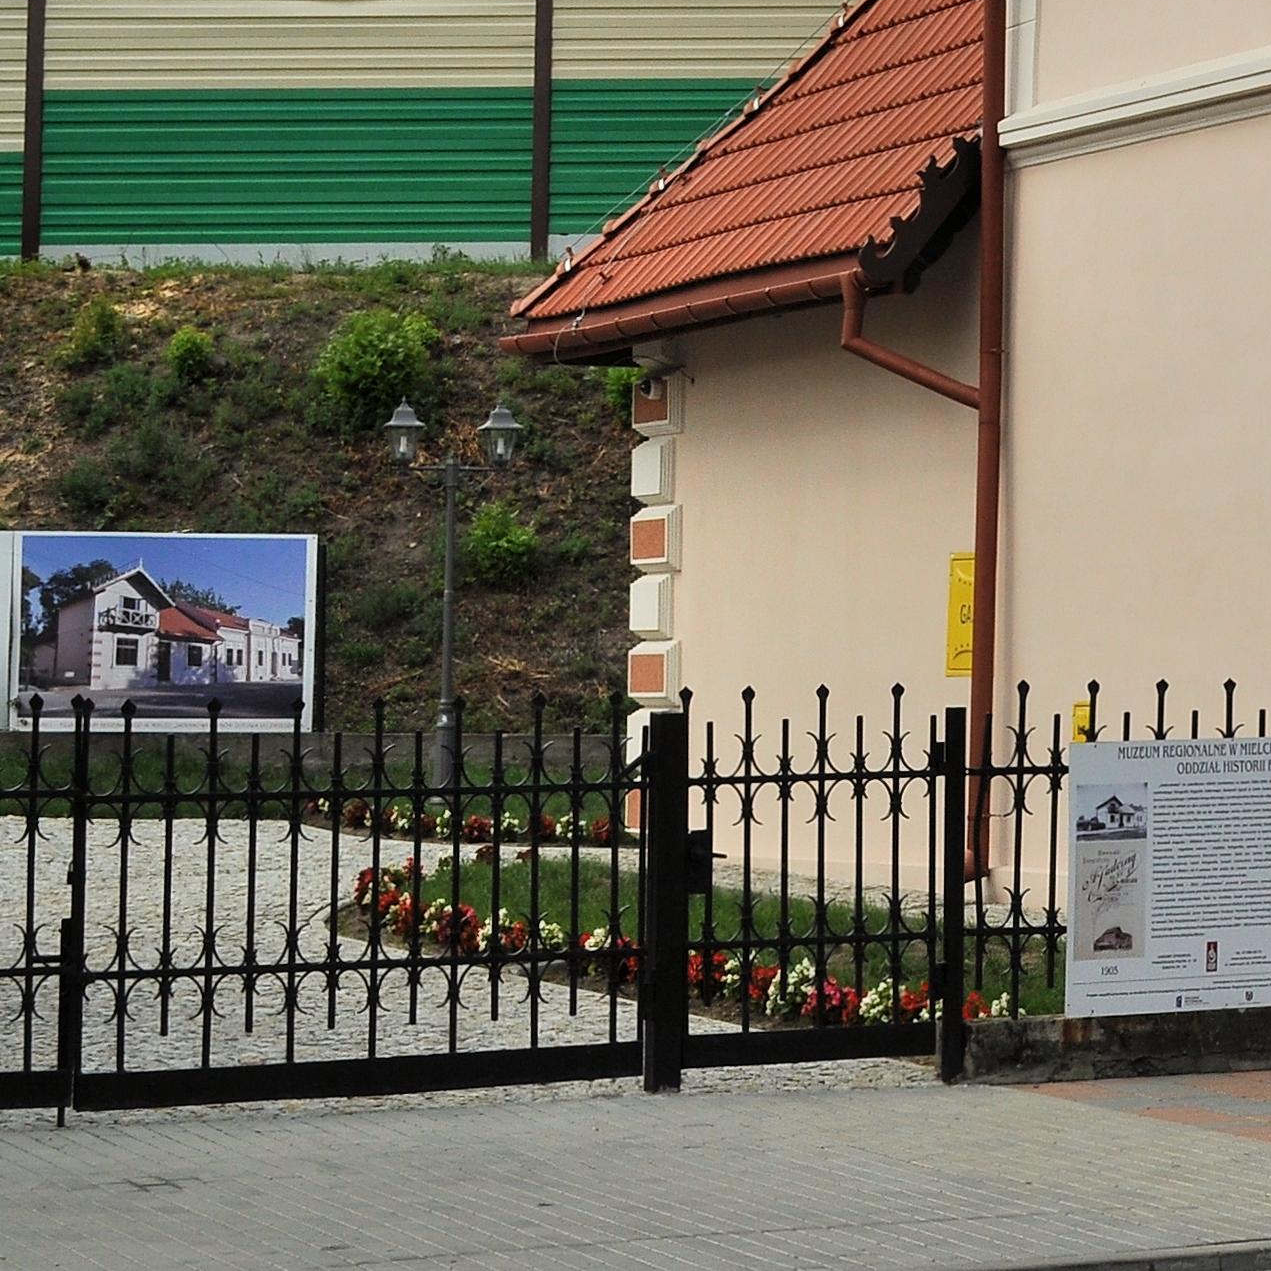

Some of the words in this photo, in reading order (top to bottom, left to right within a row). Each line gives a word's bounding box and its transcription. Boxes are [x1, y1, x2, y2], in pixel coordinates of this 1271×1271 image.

[1117, 745, 1160, 760] MUZEUM
[1162, 743, 1227, 758] REGIONALNE
[1229, 743, 1238, 756] W
[1176, 761, 1220, 775] ODDZIAŁ
[1223, 759, 1266, 773] HISTORII
